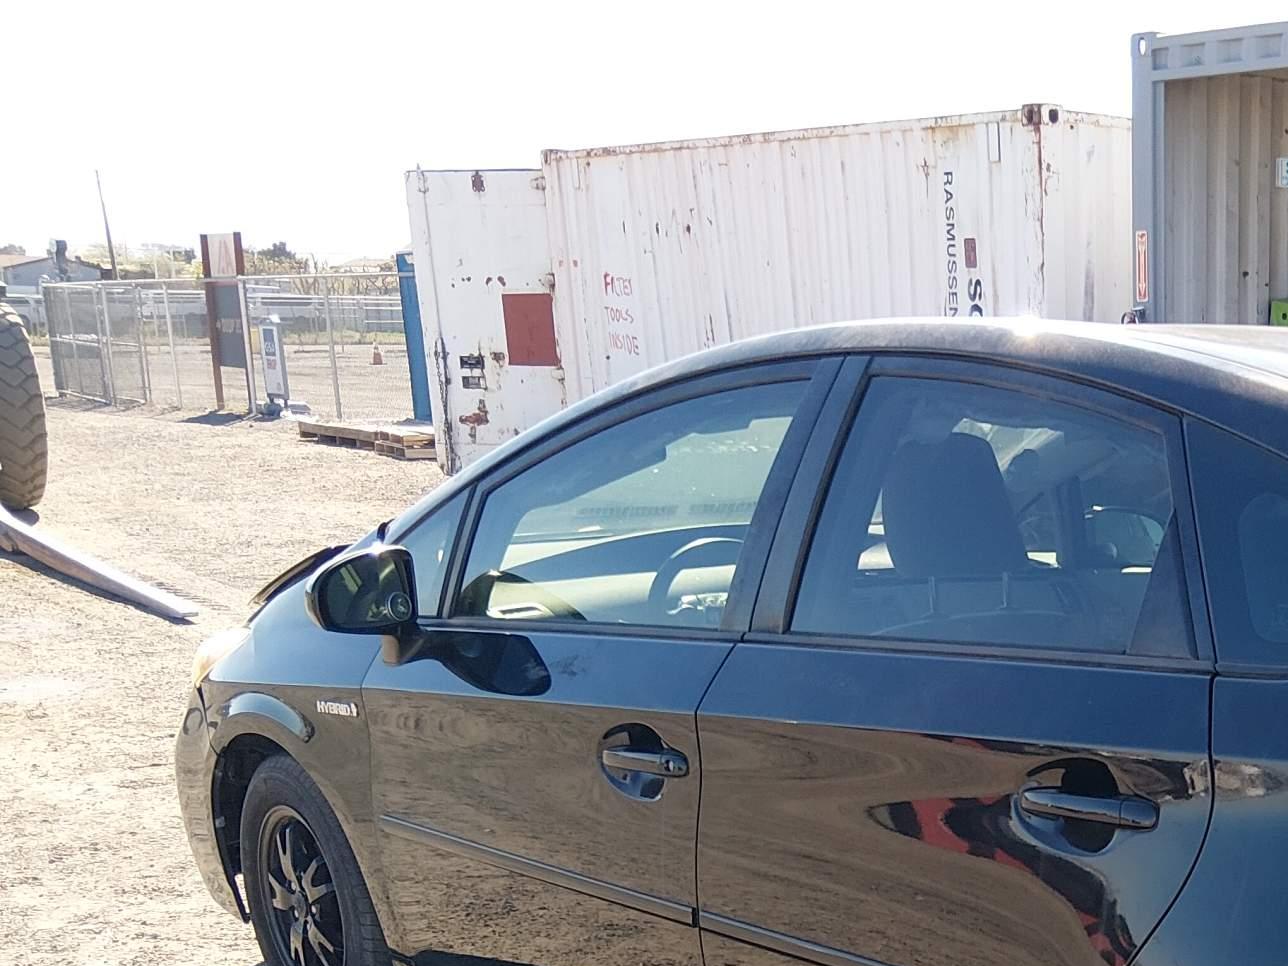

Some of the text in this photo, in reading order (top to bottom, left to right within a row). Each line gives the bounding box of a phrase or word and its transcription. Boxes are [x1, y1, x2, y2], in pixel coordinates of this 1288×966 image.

[604, 306, 634, 324] TOOLS
[608, 331, 640, 356] INSIDE
[316, 700, 351, 716] HYBRID
